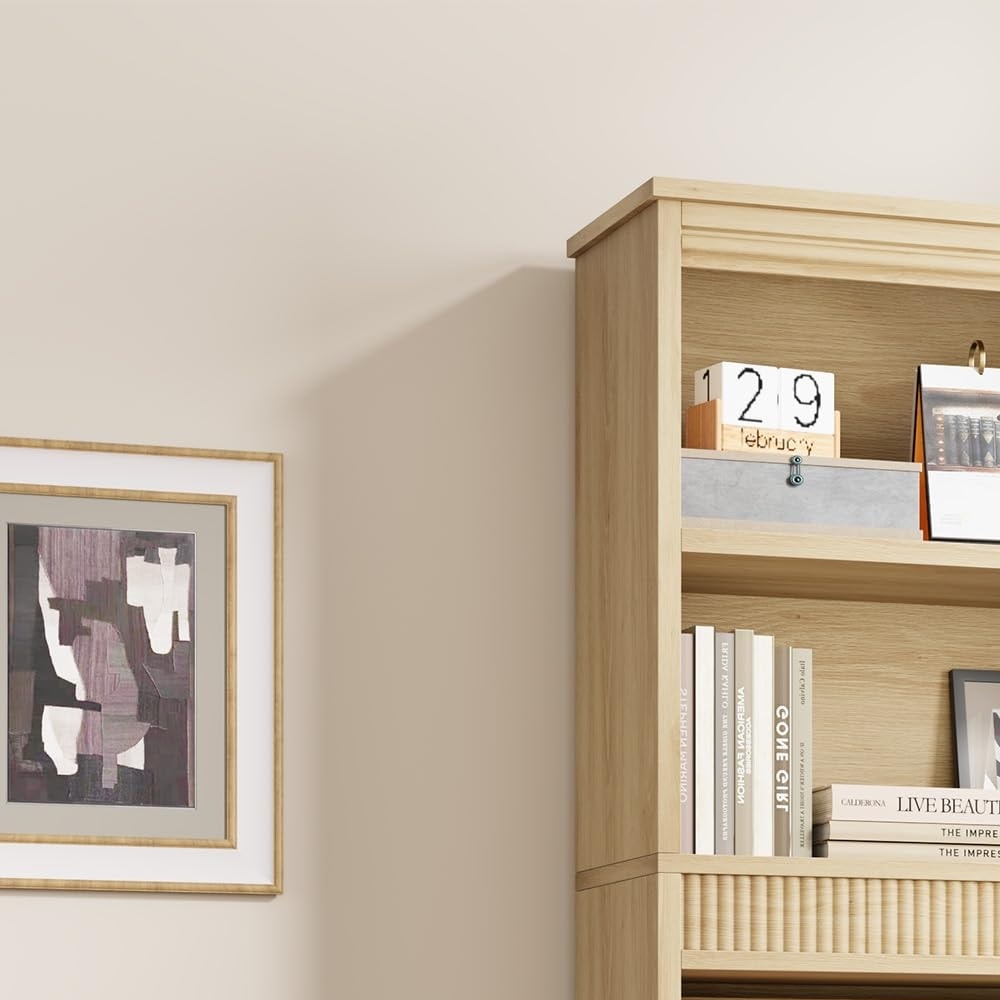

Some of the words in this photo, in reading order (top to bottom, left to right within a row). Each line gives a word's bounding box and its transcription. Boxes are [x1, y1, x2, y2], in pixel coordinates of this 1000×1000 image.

[841, 799, 886, 808] CALDERONA
[897, 797, 937, 813] LIVE
[942, 828, 961, 837] THE
[939, 848, 959, 857] THE
